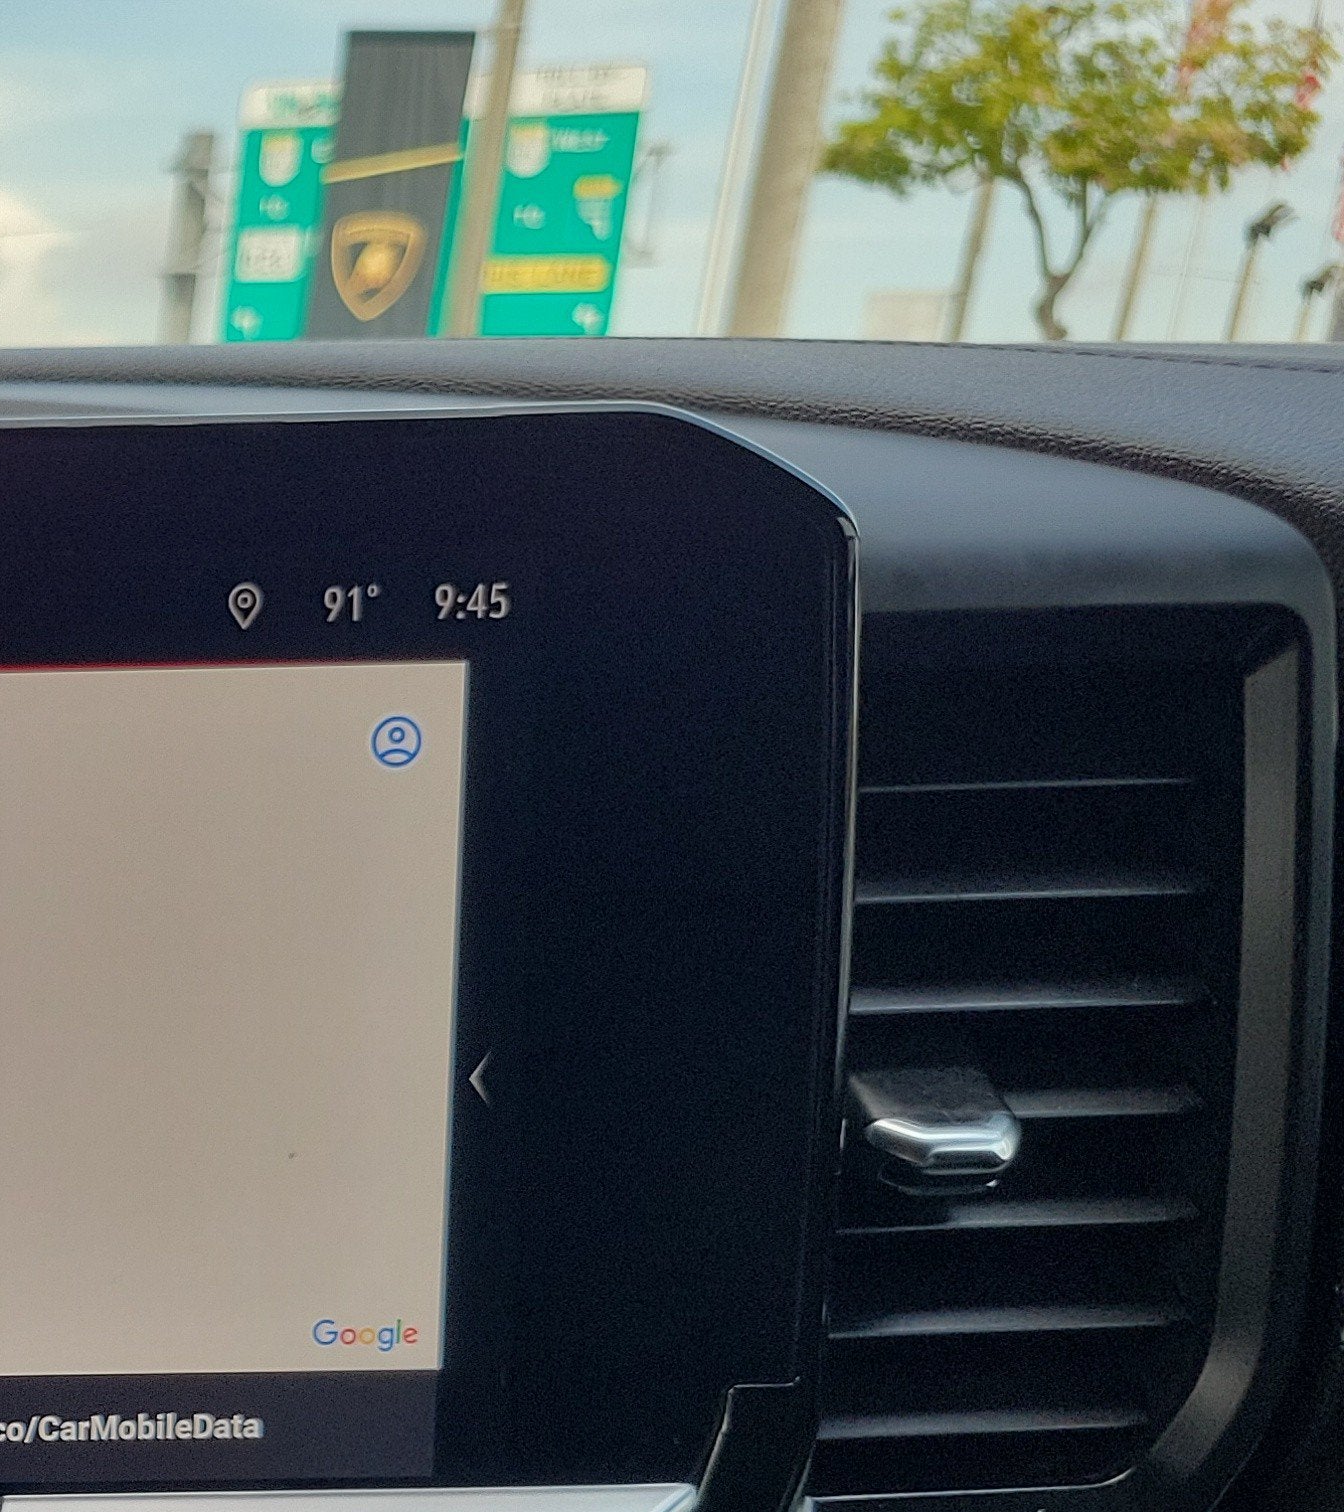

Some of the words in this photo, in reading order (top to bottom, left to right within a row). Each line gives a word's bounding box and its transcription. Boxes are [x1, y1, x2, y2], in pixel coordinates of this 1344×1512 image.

[323, 583, 381, 622] 91°
[434, 582, 510, 620] 9:45
[313, 1319, 418, 1352] Google
